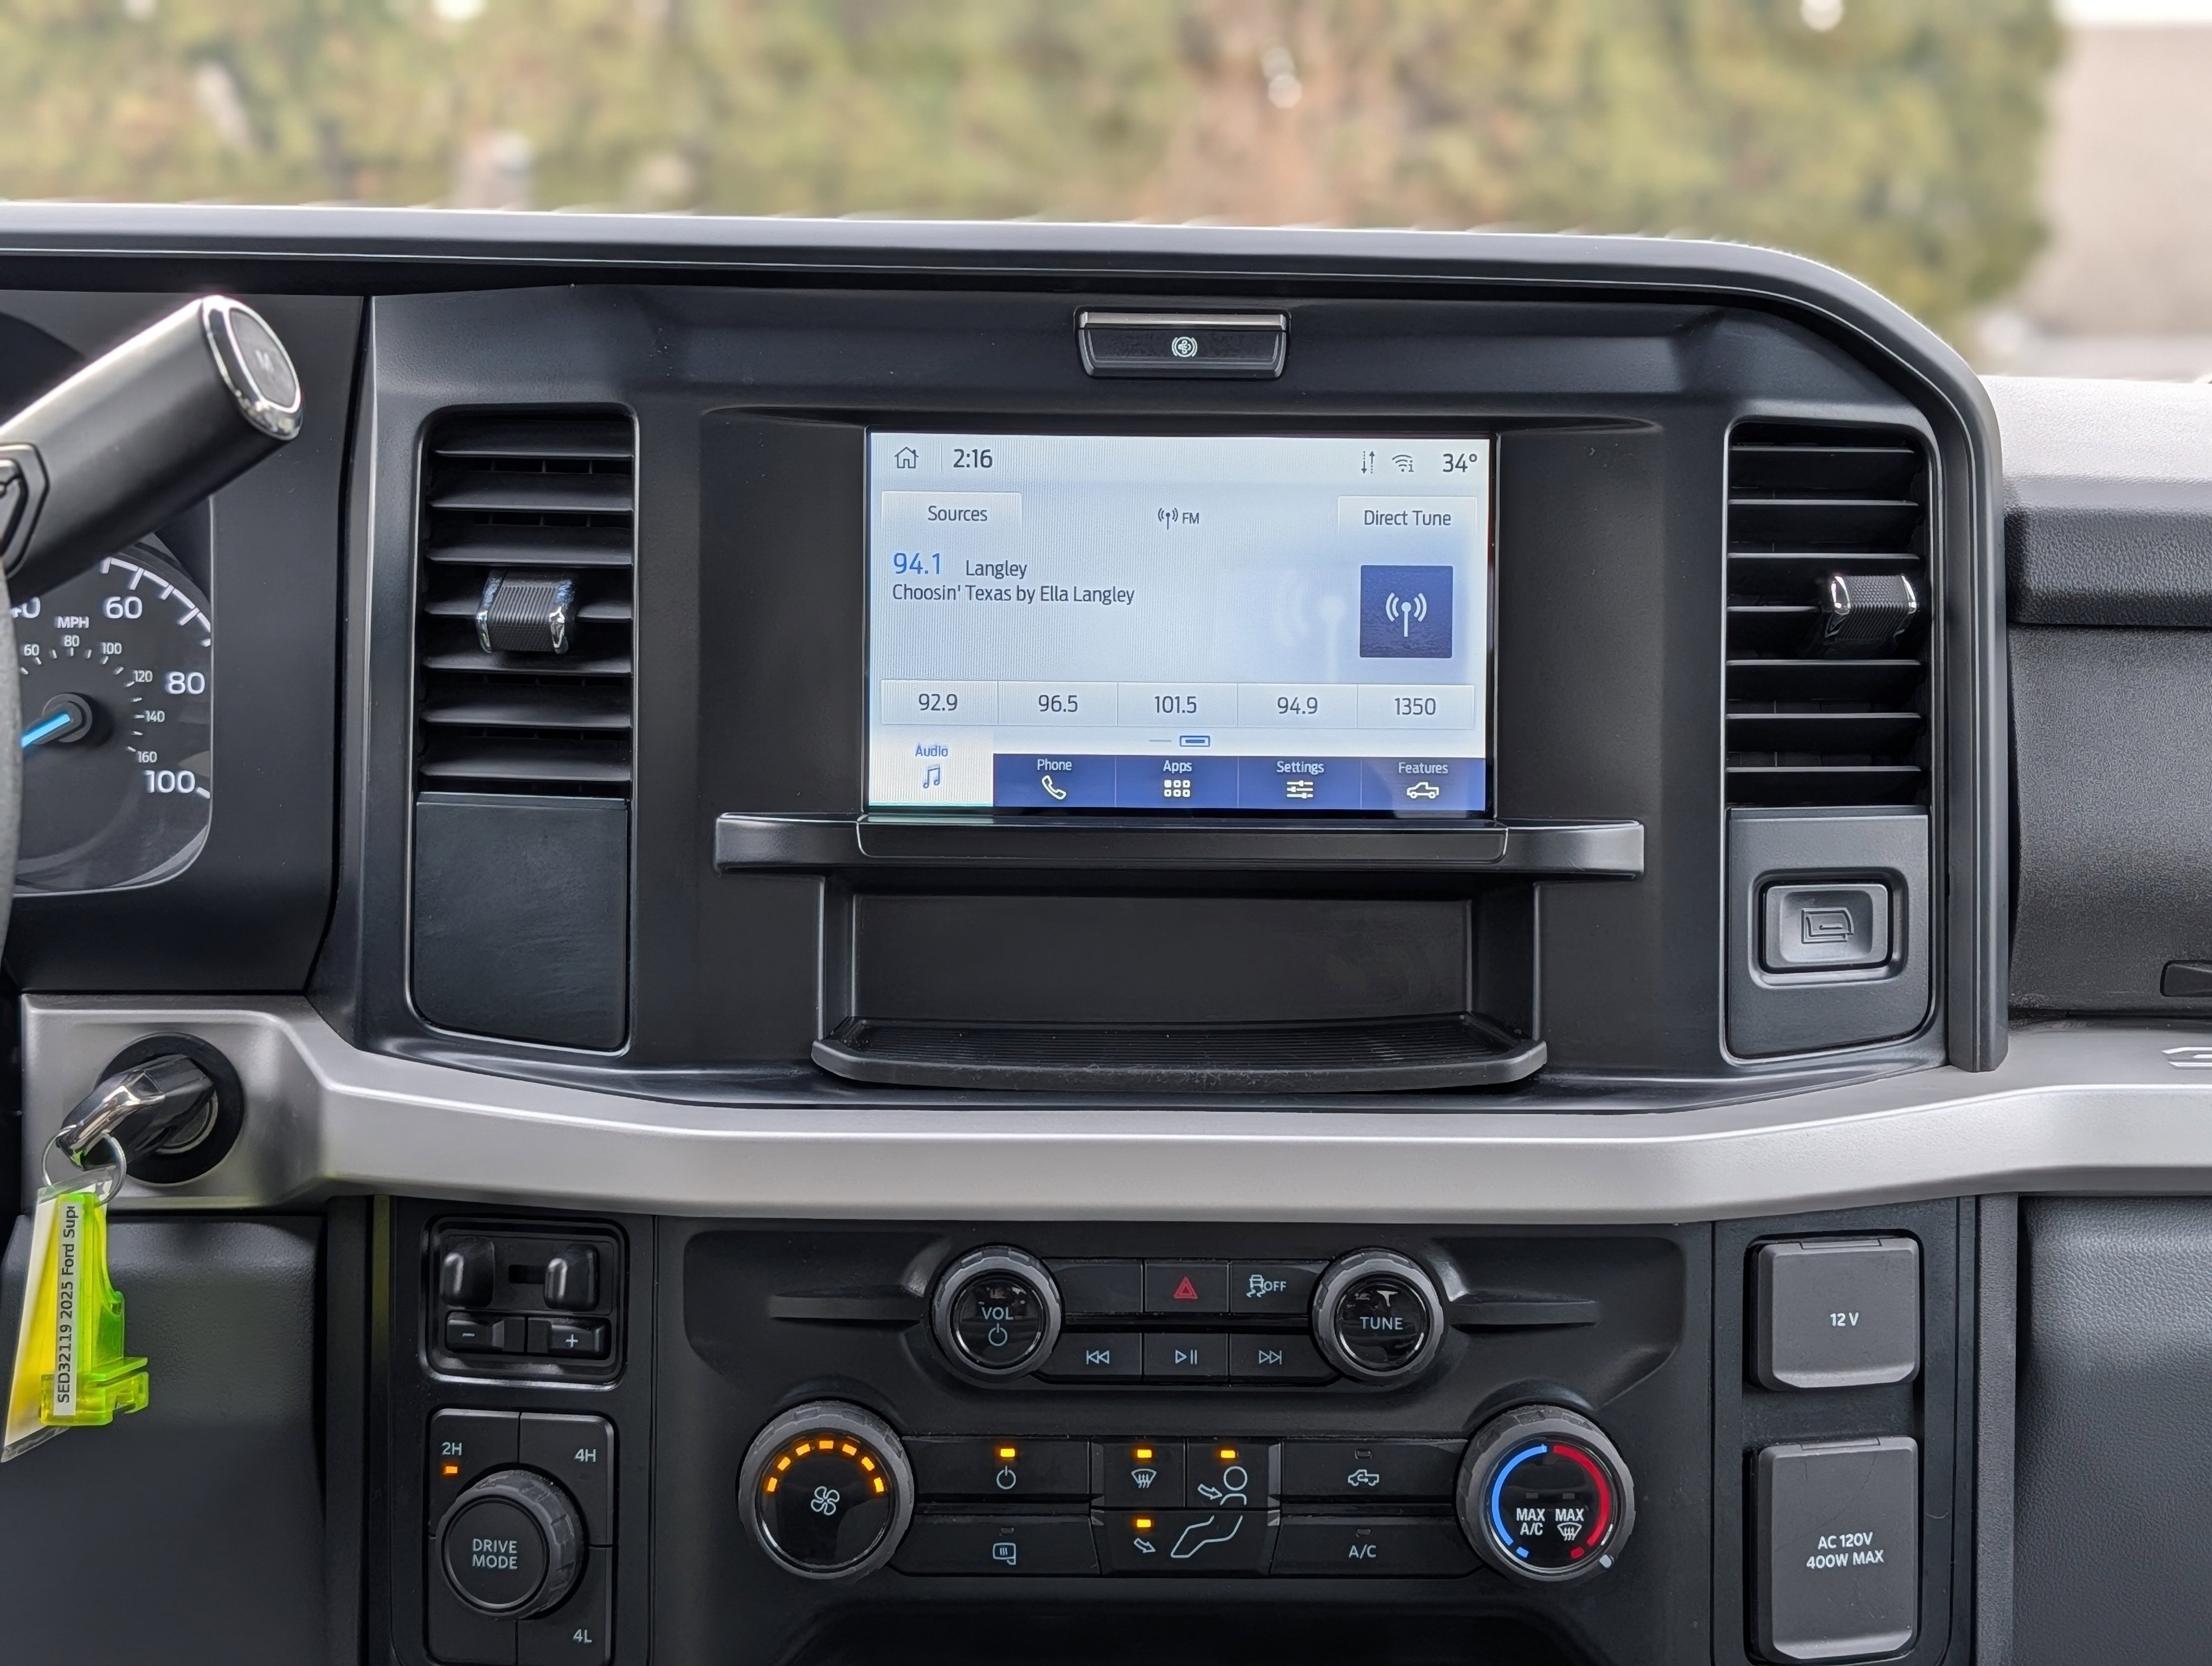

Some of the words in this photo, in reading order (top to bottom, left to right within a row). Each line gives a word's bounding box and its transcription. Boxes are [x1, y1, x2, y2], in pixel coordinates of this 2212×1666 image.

[953, 448, 993, 469] 2:16
[1442, 452, 1478, 473] 34°
[928, 505, 988, 522] Sources
[1182, 512, 1200, 525] FM
[1364, 510, 1409, 526] Direct
[1412, 510, 1451, 526] Tune
[893, 553, 941, 575] 94.1
[966, 560, 1027, 579] Langley
[892, 584, 961, 601] Choosin'
[965, 585, 1012, 601] Texas
[1016, 585, 1036, 604] by
[1040, 586, 1069, 602] Ella
[1073, 586, 1135, 605] Langley
[106, 597, 143, 619] 60
[56, 616, 89, 629] MPH
[63, 635, 80, 647] 80
[23, 644, 40, 656] 60
[101, 643, 123, 655] 100
[133, 670, 153, 683] 120
[167, 672, 205, 694] 80
[918, 694, 958, 712] 92.9
[1038, 695, 1078, 713] 96.5
[1154, 696, 1197, 714] 101.5
[1277, 697, 1318, 715] 94.9
[1394, 698, 1436, 715] 1350
[145, 710, 165, 722] 140
[137, 751, 157, 763] 160
[915, 744, 948, 758] Audio
[1037, 759, 1072, 771] Phone
[1163, 760, 1192, 774] Apps
[1276, 761, 1324, 775] Settings
[1398, 762, 1448, 774] Features
[144, 770, 196, 793] 100
[62, 1244, 75, 1275] Ford
[1263, 1280, 1287, 1292] OFF
[61, 1281, 73, 1319] 2025
[981, 1306, 1014, 1321] VOL
[1830, 1312, 1847, 1327] 12
[1847, 1312, 1859, 1327] V
[1359, 1316, 1403, 1330] TUNE
[58, 1324, 73, 1404] SED32119
[441, 1441, 462, 1456] 2H
[574, 1448, 597, 1463] 4H
[1516, 1508, 1545, 1522] MAX
[1555, 1508, 1584, 1522] MAX
[1520, 1522, 1544, 1536] A/C
[472, 1539, 518, 1554] DRIVE
[1817, 1535, 1837, 1549] AC
[1840, 1532, 1874, 1547] 120V
[1348, 1545, 1377, 1559] A/C
[1806, 1553, 1849, 1569] 400W
[1852, 1550, 1885, 1565] MAX
[472, 1555, 518, 1569] MODE
[573, 1629, 593, 1643] 4L
